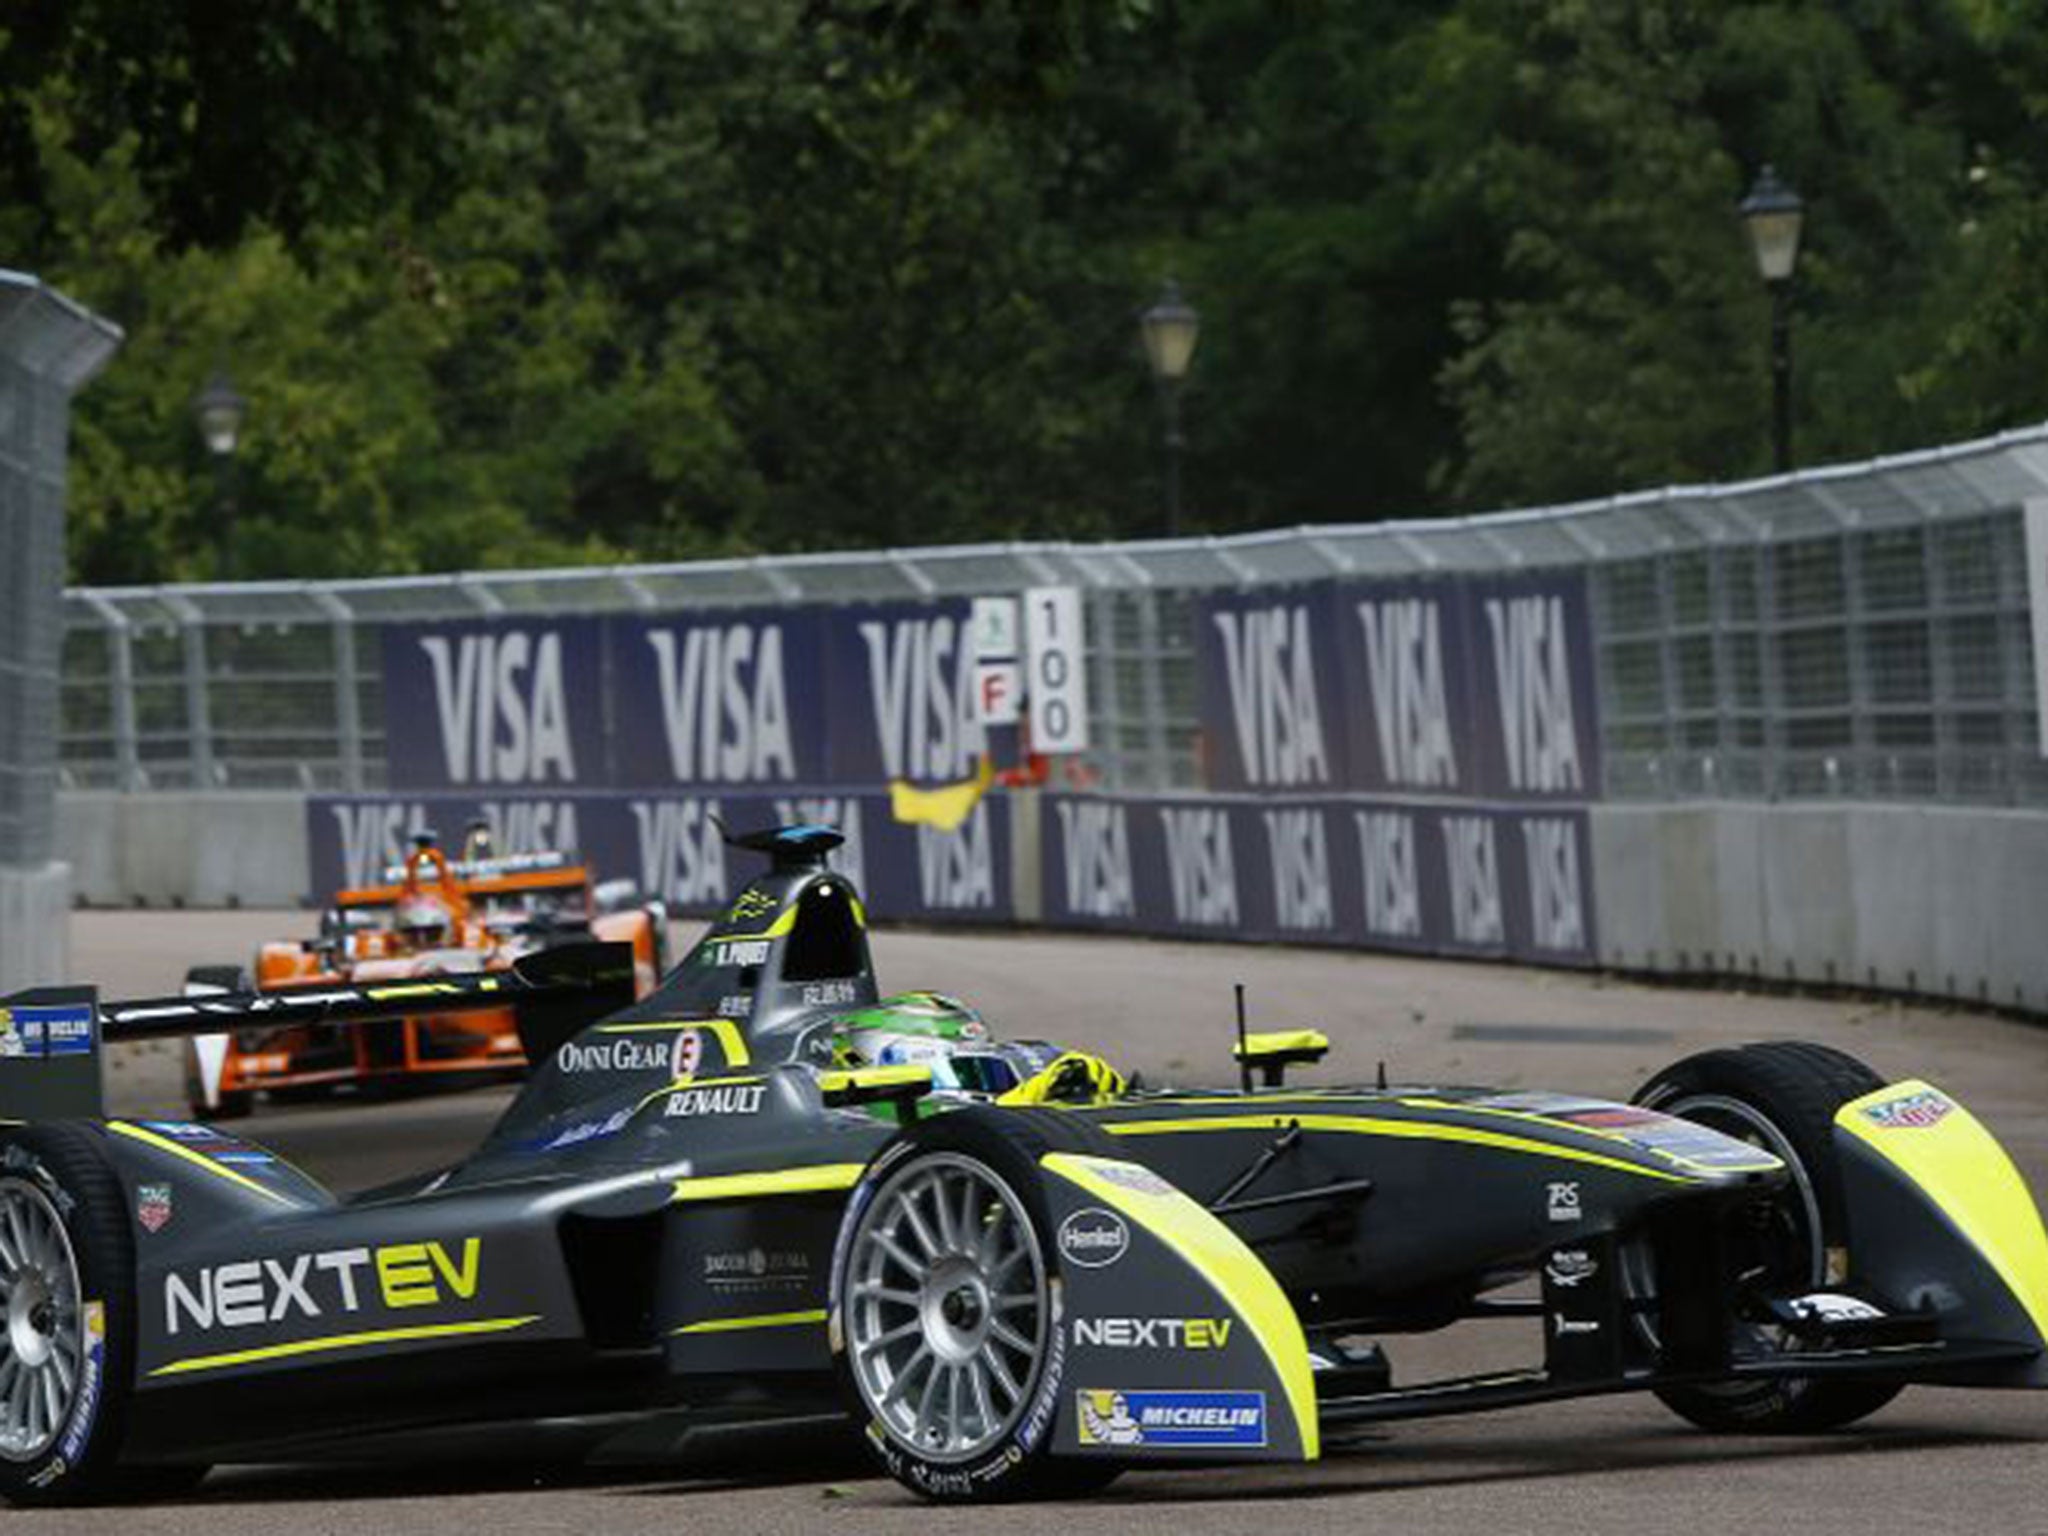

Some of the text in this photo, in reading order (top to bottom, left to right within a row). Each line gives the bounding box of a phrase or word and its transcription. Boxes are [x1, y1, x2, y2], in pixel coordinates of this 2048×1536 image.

[420, 632, 575, 782] VISA
[647, 625, 796, 782] VISA
[983, 674, 1005, 714] F
[1214, 606, 1328, 784] VISA
[1358, 600, 1457, 786] VISA
[1486, 596, 1582, 790] VISA
[630, 800, 727, 903] VISA
[1058, 802, 1135, 916] VISA
[1161, 808, 1239, 925] VISA
[1264, 811, 1333, 929] VISA
[1355, 812, 1421, 936] VISA
[1442, 817, 1503, 941] VISA
[1522, 819, 1584, 948] VISA
[665, 1086, 767, 1117] RENAULT
[164, 1237, 481, 1334] NEXTEV
[1065, 1226, 1122, 1248] Henkel
[1074, 1318, 1231, 1348] NEXTEV
[1141, 1406, 1258, 1426] MICHELIN
